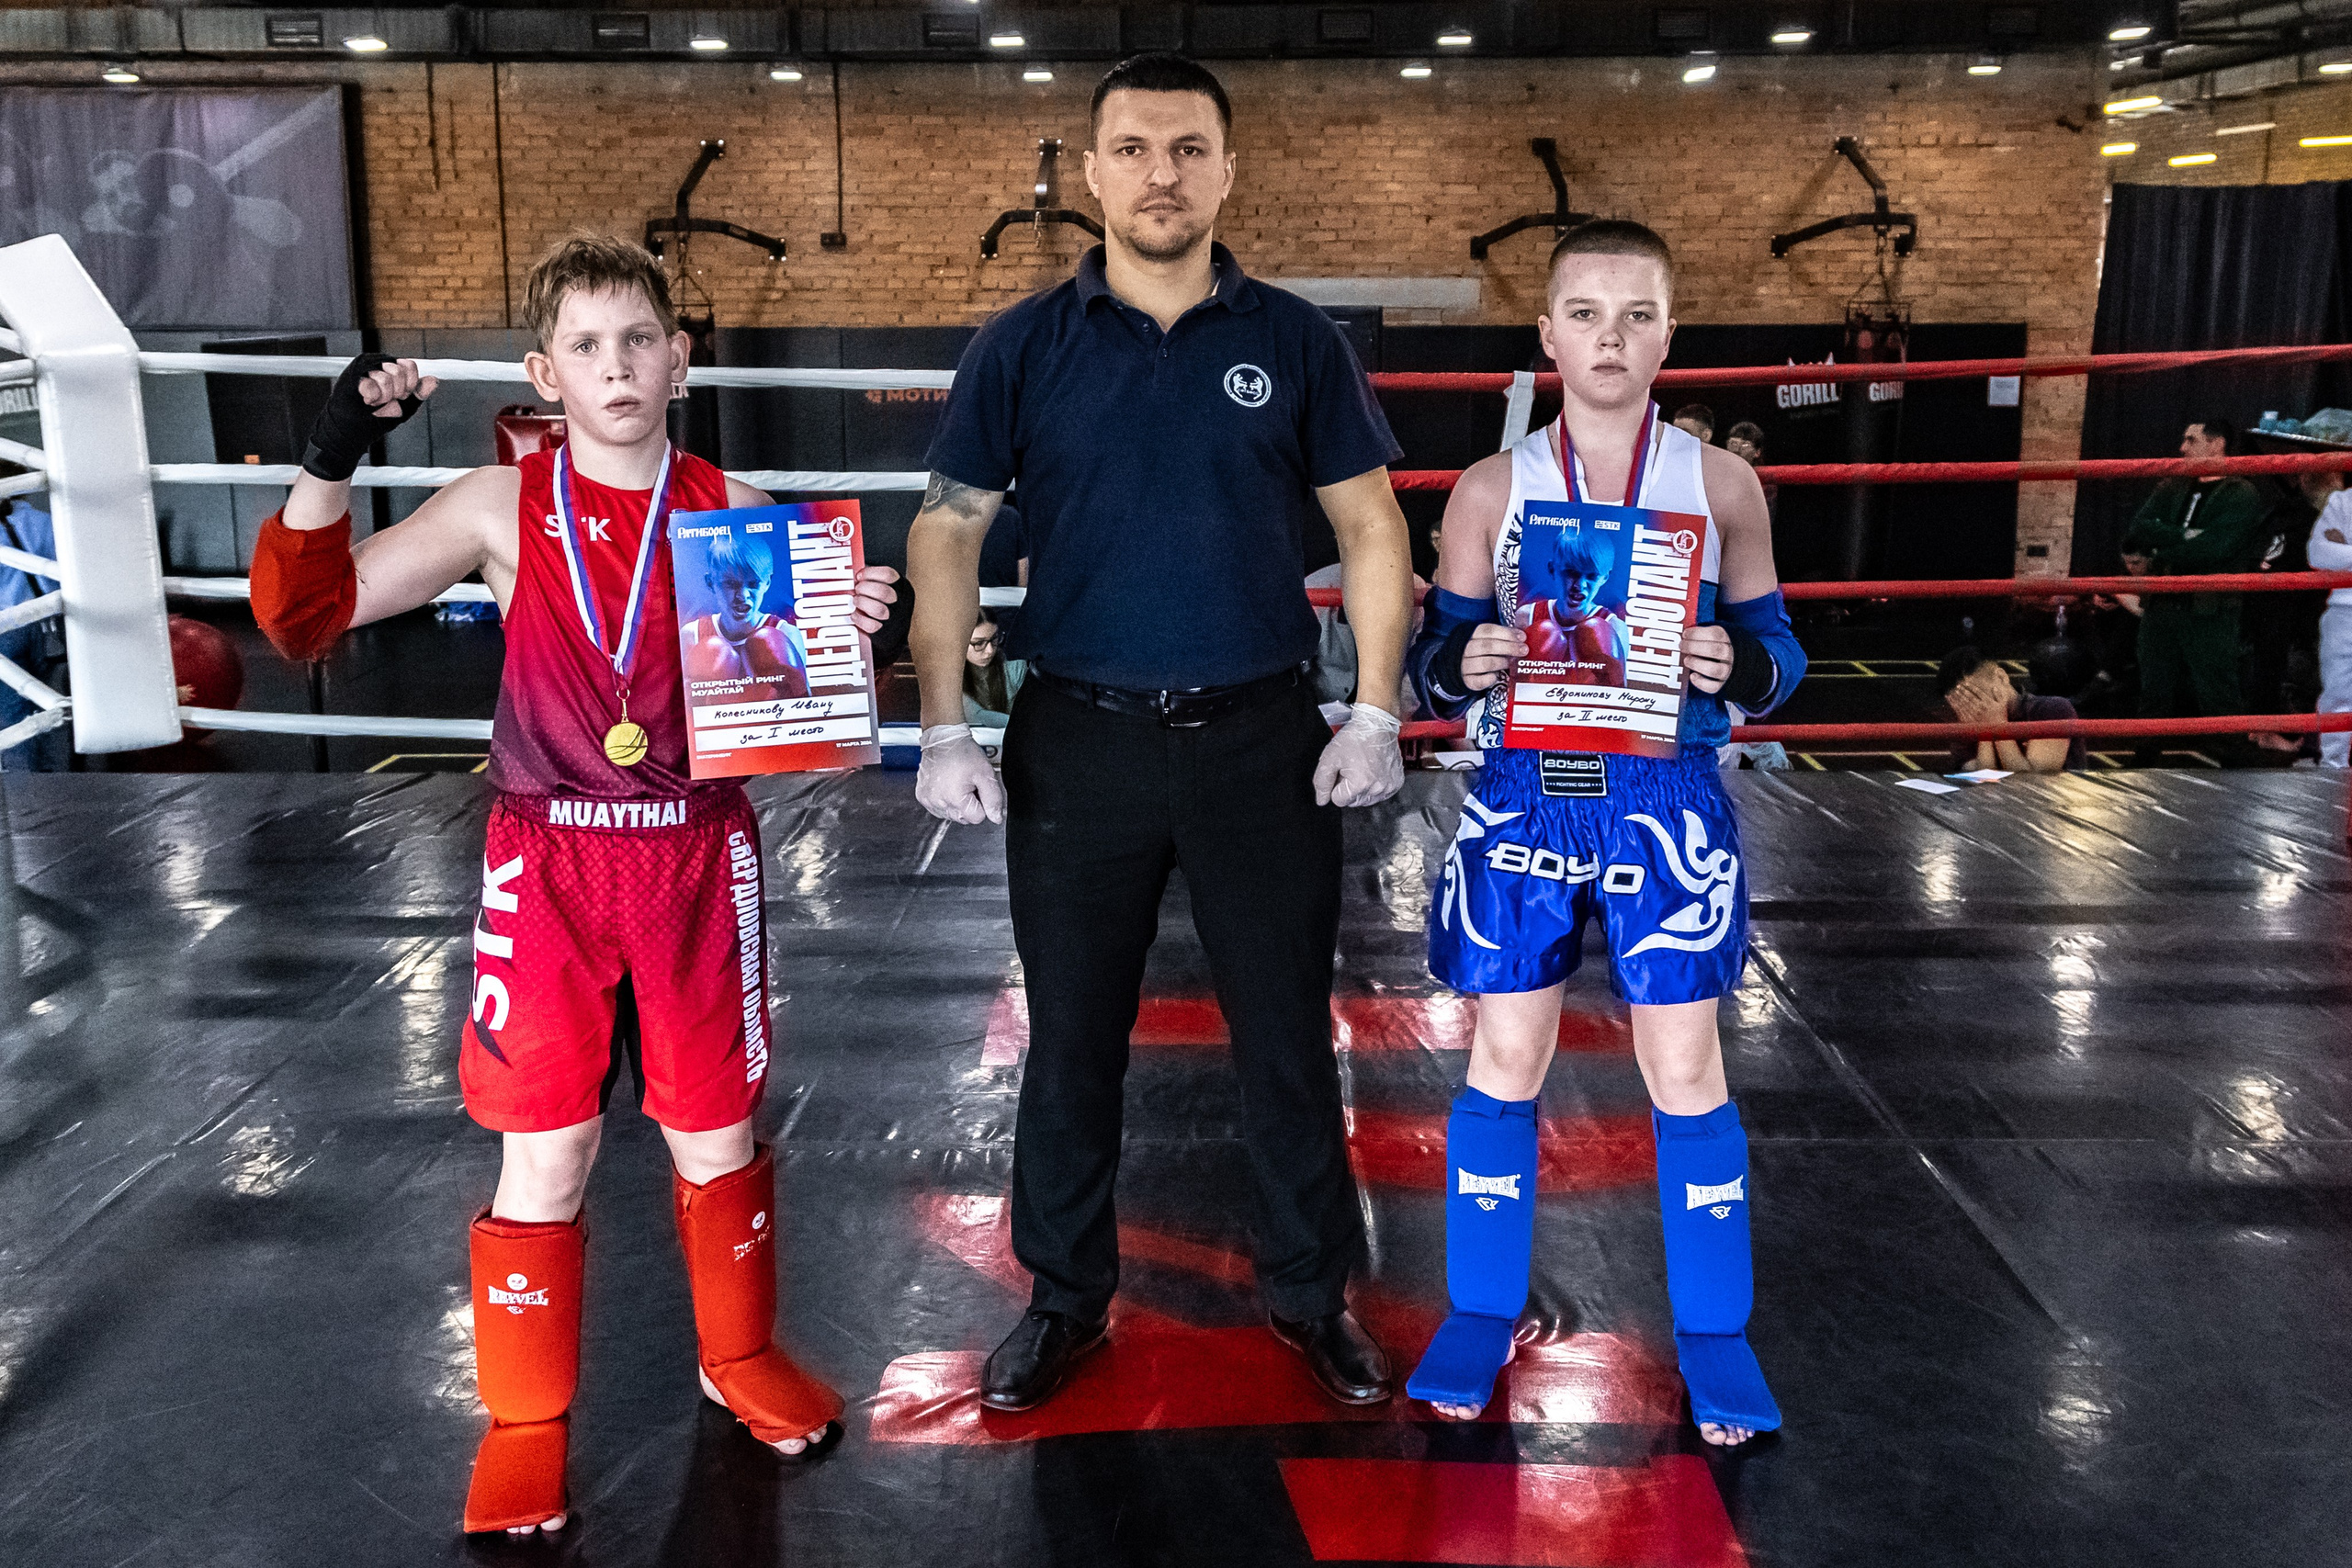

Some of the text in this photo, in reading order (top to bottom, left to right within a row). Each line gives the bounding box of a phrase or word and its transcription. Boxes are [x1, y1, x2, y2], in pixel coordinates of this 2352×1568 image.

[1776, 383, 1840, 409] GORILL
[544, 513, 612, 542] SK
[787, 519, 867, 689] ДЕБЮТАНТ
[1624, 524, 1692, 690] ДЕБЮТАНТ
[1517, 660, 1606, 670] ОТКРЫТЫЙ РИНГ
[1517, 667, 1566, 676] МУАЙТАЙ
[691, 674, 786, 689] ОТКРЫТЫЙ РИНГ
[691, 686, 744, 697] МУАЙТАЙ
[1556, 712, 1576, 721] за
[1595, 715, 1628, 723] место
[740, 726, 824, 745] за I место
[1544, 759, 1600, 770] BOYBO
[548, 799, 686, 828] MUAYTHAI
[1485, 842, 1645, 895] BOYO
[472, 850, 525, 1032] STK
[728, 830, 769, 1083] СВЕРДЛОВСКАЯ ОБЛАСТЬ
